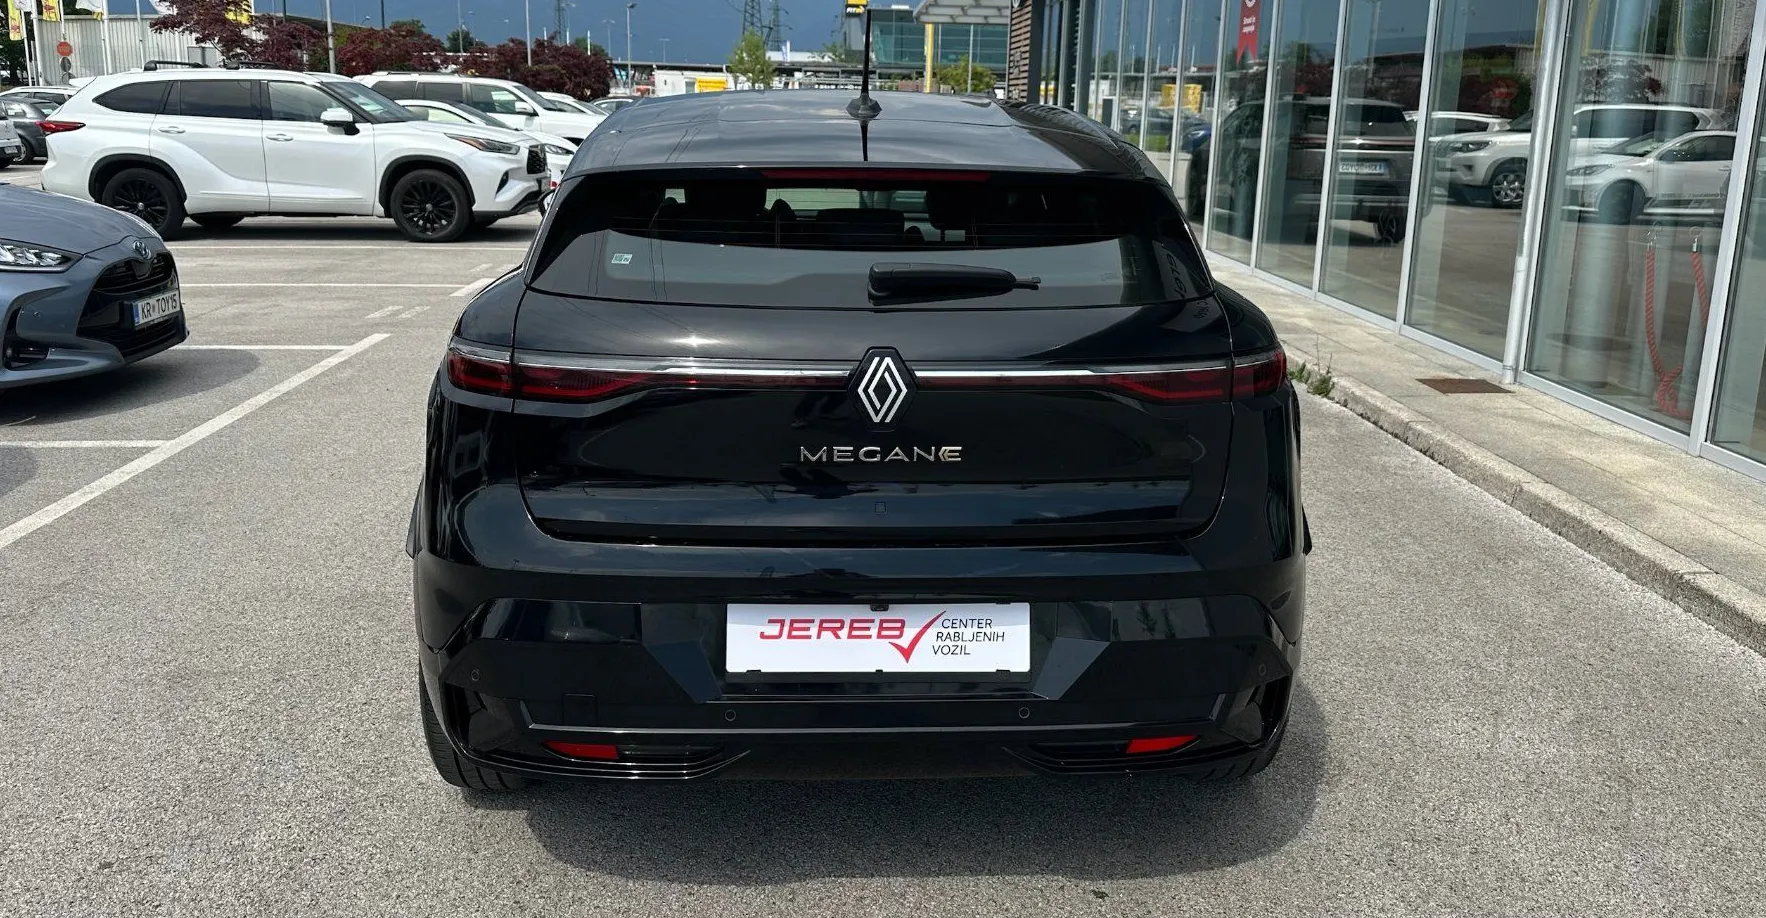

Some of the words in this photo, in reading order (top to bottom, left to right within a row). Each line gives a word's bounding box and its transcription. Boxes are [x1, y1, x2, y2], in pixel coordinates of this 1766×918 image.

[141, 302, 152, 320] KR
[156, 293, 178, 314] TOY15
[800, 446, 962, 462] MEGANE
[759, 618, 906, 640] JEREB
[941, 618, 993, 629] CENTER
[935, 631, 1005, 642] RABLJENIH
[932, 645, 971, 656] VOZIL
